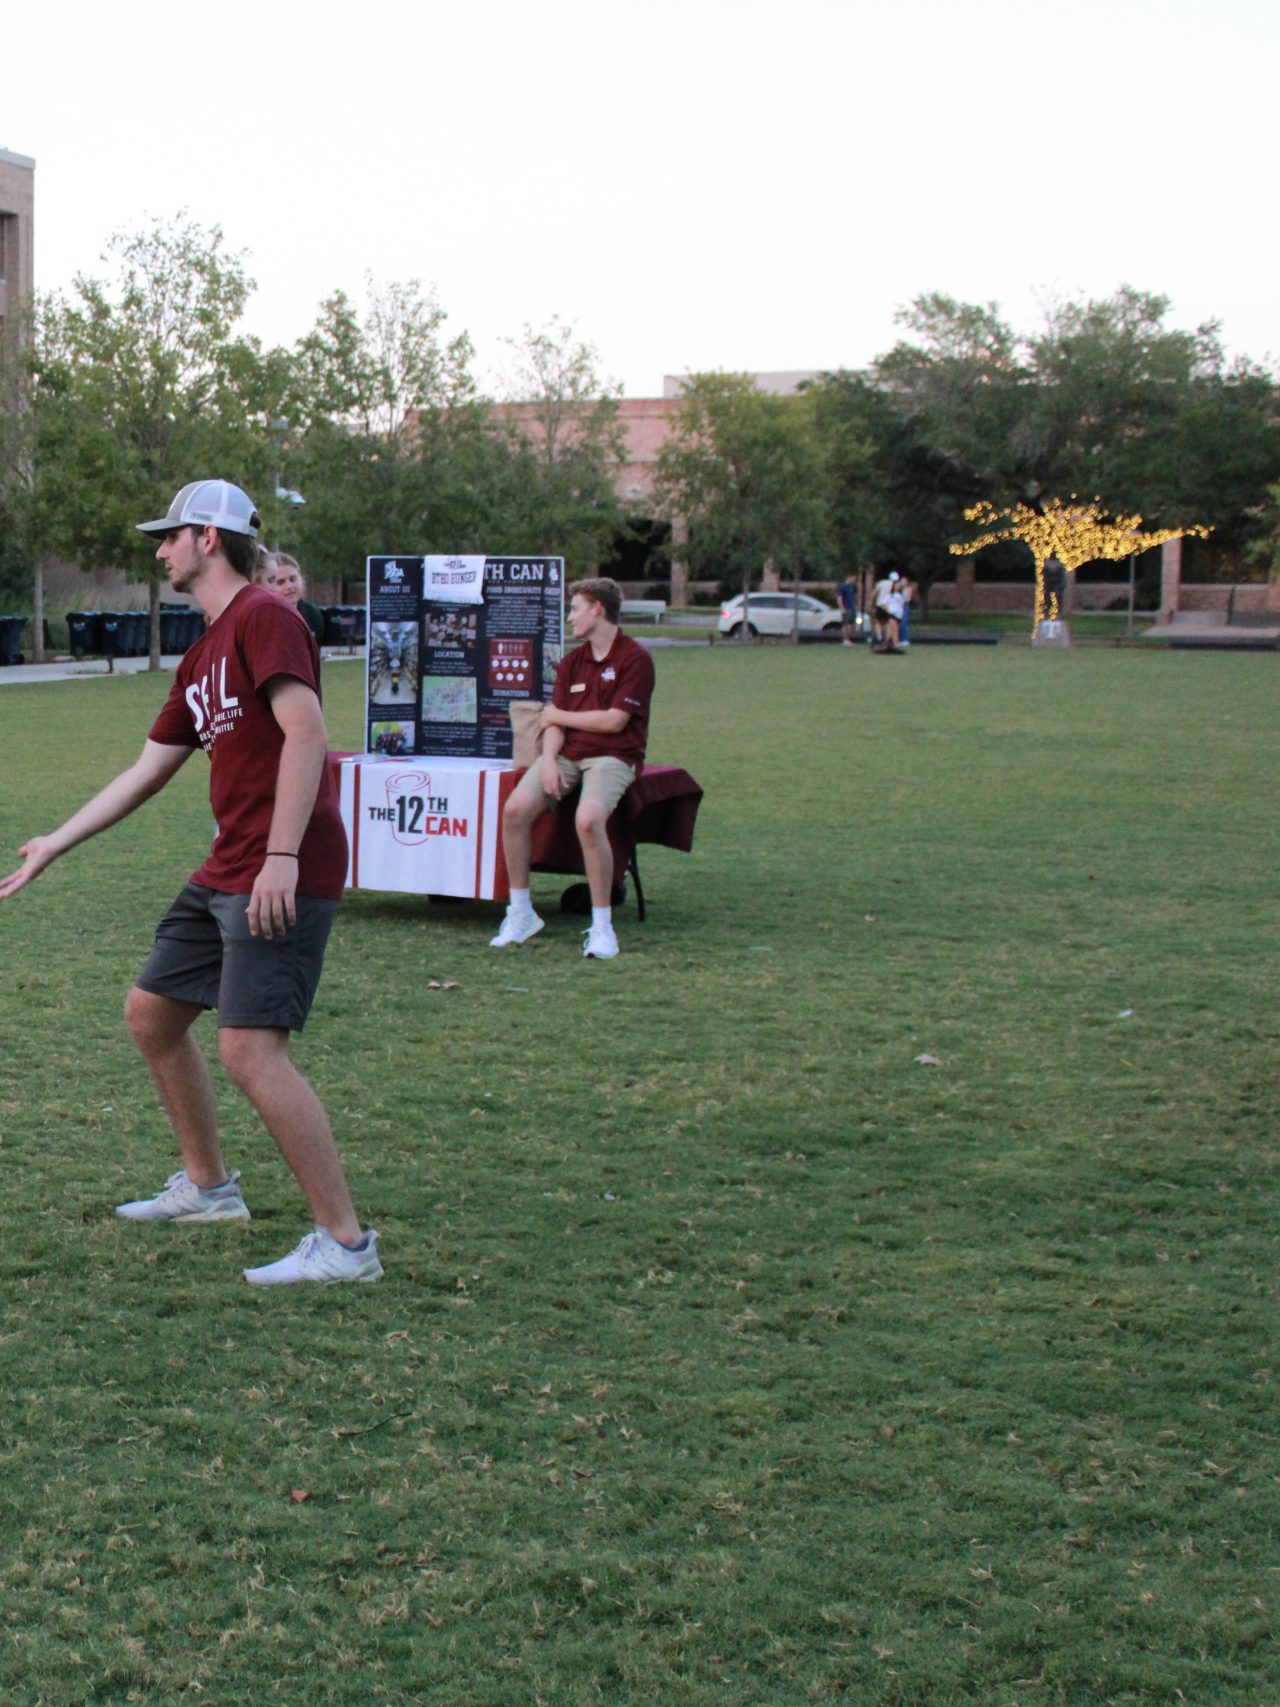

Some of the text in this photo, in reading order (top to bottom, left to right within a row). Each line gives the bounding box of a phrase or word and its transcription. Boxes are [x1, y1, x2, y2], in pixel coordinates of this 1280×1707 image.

[510, 563, 545, 580] CAN
[434, 650, 465, 659] LOCATION
[227, 708, 244, 719] LIFE
[368, 795, 449, 834] THE 12 TH
[425, 816, 468, 838] CAN
